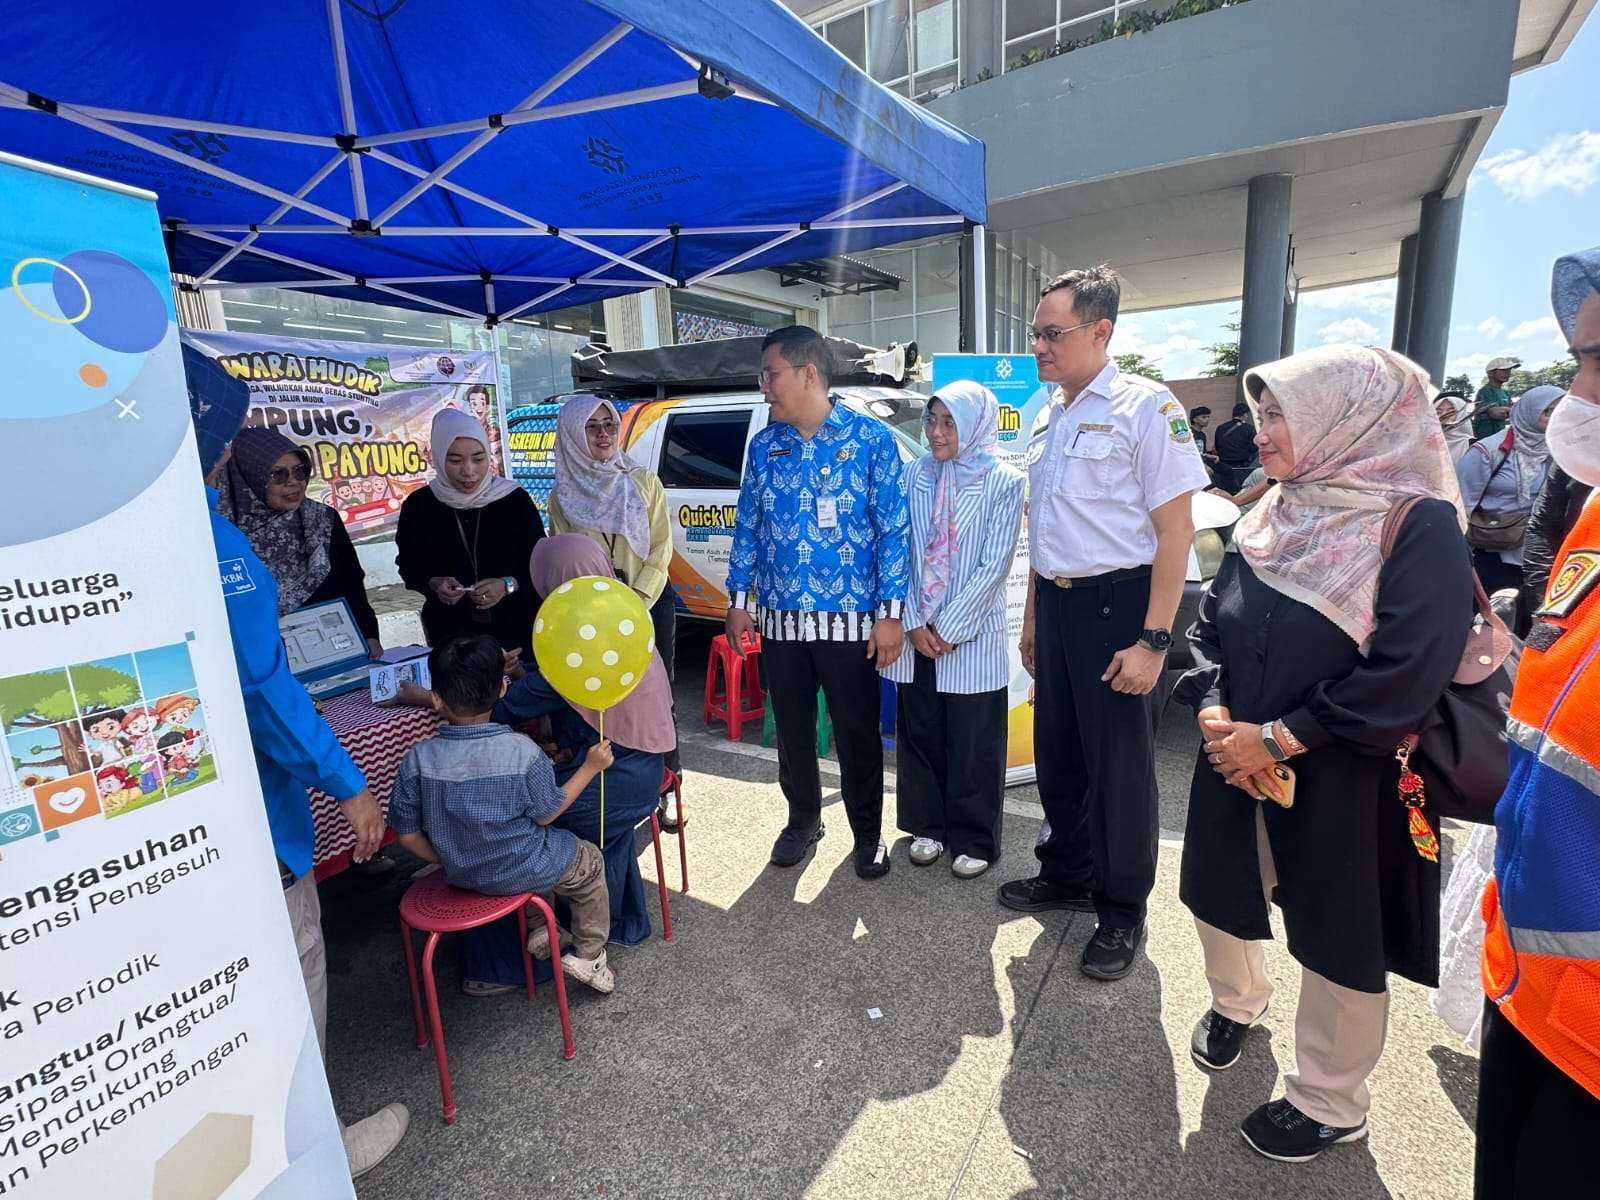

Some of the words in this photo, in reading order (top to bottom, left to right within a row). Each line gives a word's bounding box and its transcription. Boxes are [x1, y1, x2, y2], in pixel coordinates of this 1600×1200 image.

[305, 385, 324, 394] ANAK
[325, 387, 347, 398] BEBAS
[306, 356, 380, 395] MUDIK
[278, 395, 301, 403] JALUR
[316, 441, 427, 480] PAYUNG.
[679, 504, 722, 528] Quick
[0, 571, 119, 602] eluarga
[0, 591, 134, 630] idupan”
[0, 824, 208, 919] engasuhan
[0, 903, 81, 951] tensi
[89, 846, 221, 915] Pengasuh
[0, 1020, 23, 1039] a
[33, 952, 161, 1026] Periodik
[0, 1019, 126, 1103] angtua/
[135, 956, 250, 1030] Keluarga
[0, 1070, 96, 1133] sipasi
[105, 984, 237, 1072] Orangtua/
[38, 1030, 249, 1169] Perkembangan
